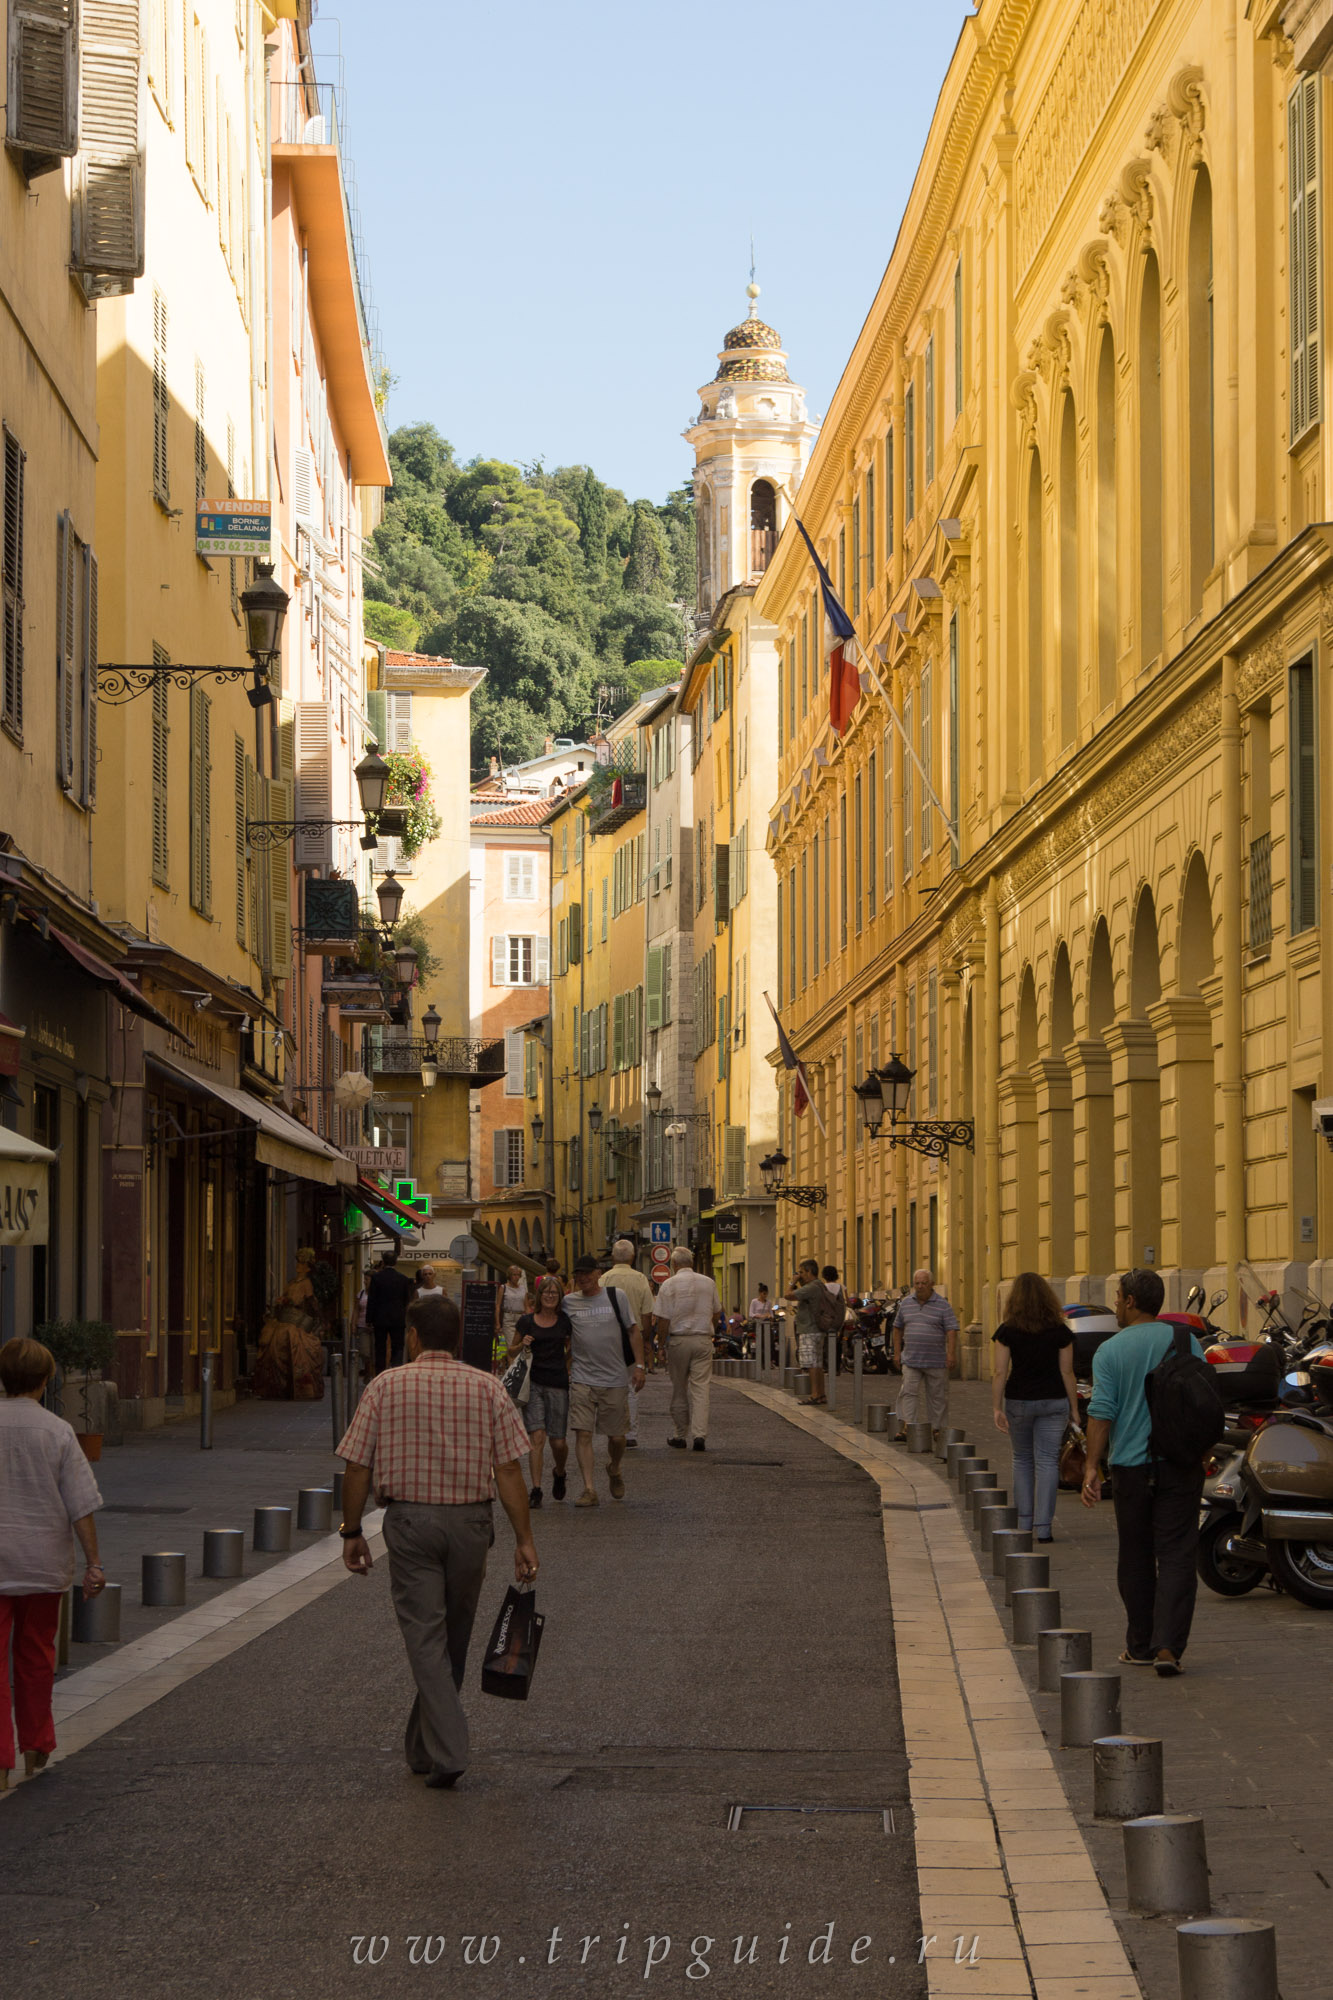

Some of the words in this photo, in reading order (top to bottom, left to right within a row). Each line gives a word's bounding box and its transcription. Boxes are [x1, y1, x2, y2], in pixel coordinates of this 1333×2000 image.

[199, 501, 209, 512] A
[215, 501, 269, 513] VENDRE
[232, 517, 260, 525] BORNE
[227, 524, 269, 532] DELAUNAY
[197, 540, 211, 550] 04
[213, 540, 226, 551] 93
[228, 541, 241, 551] 62
[243, 541, 255, 552] 25
[258, 542, 270, 553] 35
[345, 1149, 402, 1168] TOILETTAGE
[0, 1186, 39, 1231] ANT
[493, 1604, 514, 1655] NESPRESSO
